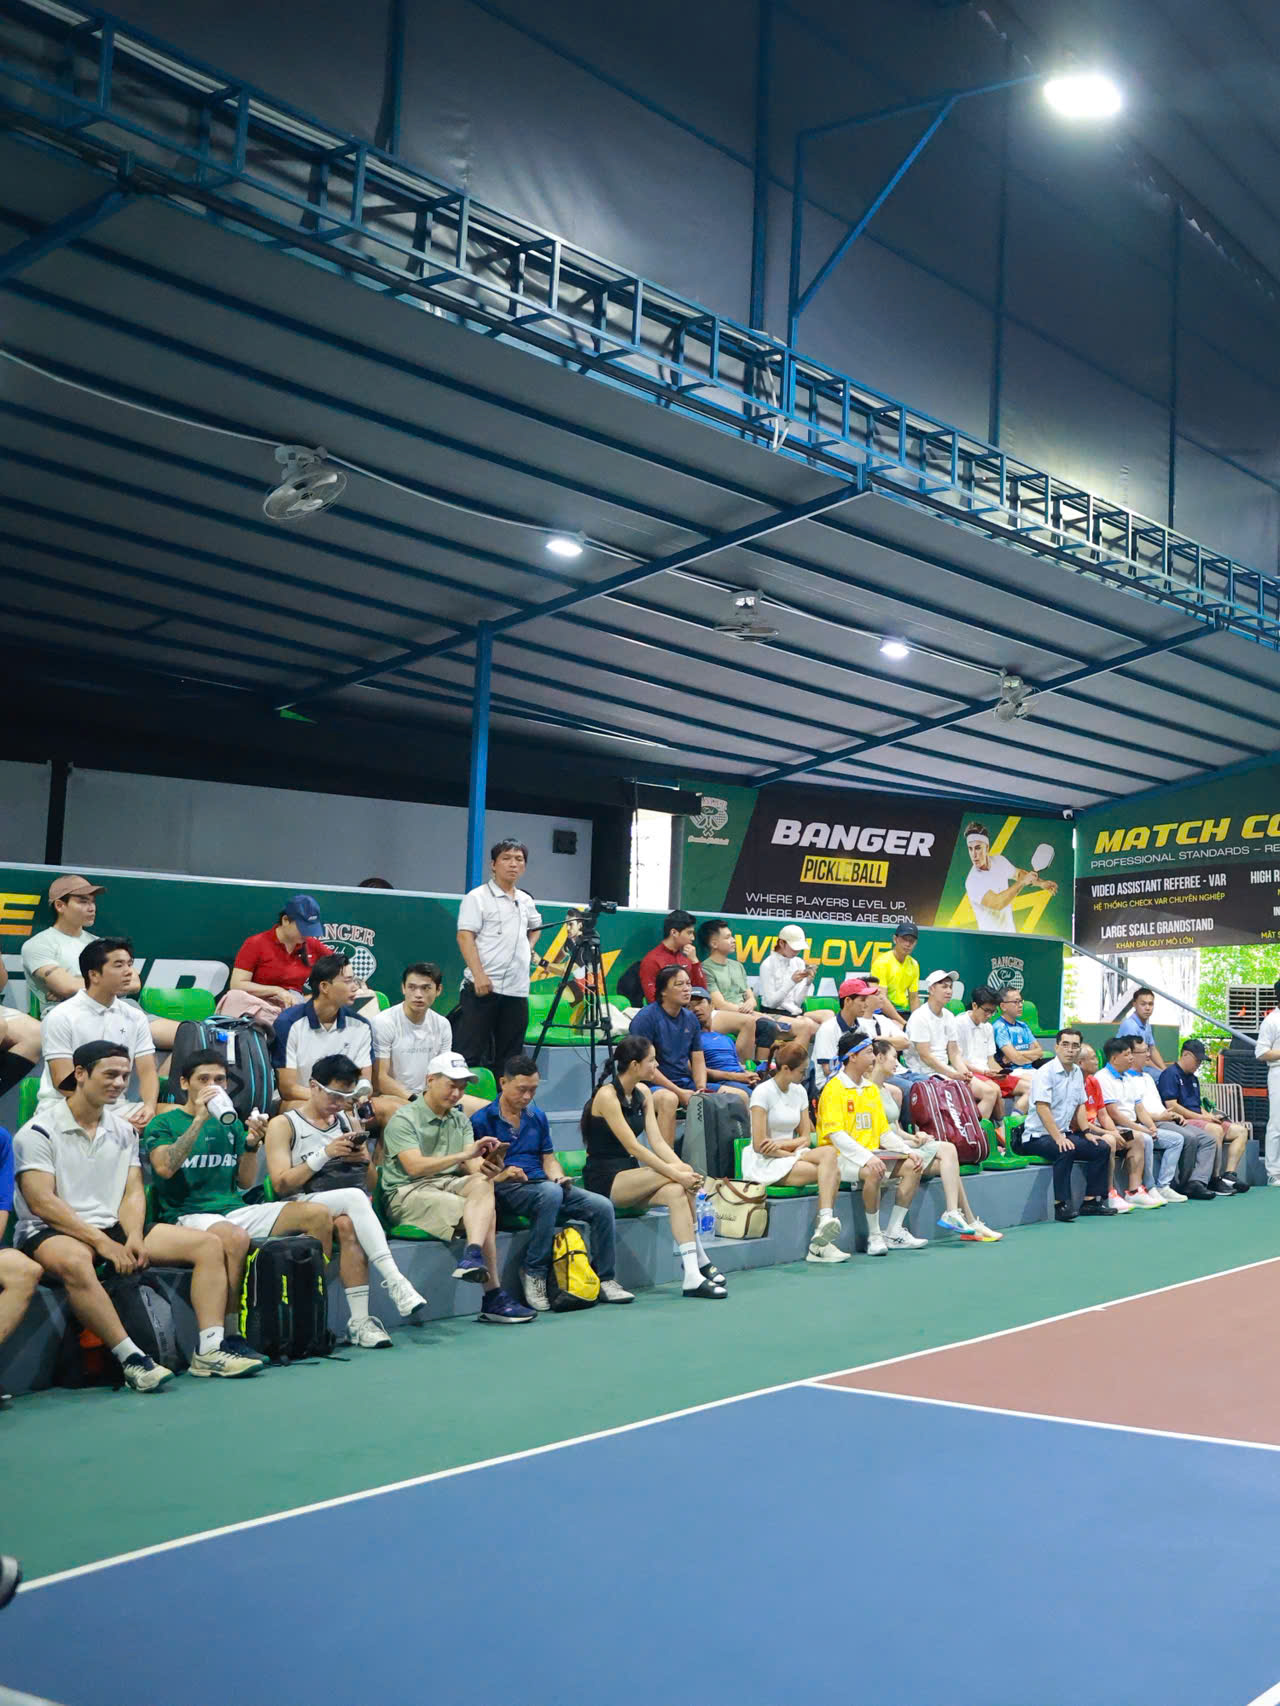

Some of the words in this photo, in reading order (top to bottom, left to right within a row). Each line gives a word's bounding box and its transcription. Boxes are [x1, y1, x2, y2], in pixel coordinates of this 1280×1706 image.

[771, 818, 936, 857] BANGER
[1094, 817, 1232, 854] MATCH
[1090, 853, 1175, 869] PROFESSIONAL
[1178, 846, 1250, 860] STANDARDS
[1091, 883, 1116, 898] VIDEO
[1117, 879, 1162, 895] ASSISTANT
[1163, 875, 1201, 891] REFEREE
[1208, 873, 1227, 887] VAR
[1250, 870, 1272, 884] HIGH
[745, 892, 793, 905] WHERE
[795, 895, 850, 908] PLAYERS
[852, 899, 887, 910] LEVEL
[889, 901, 908, 911] UP.
[1129, 898, 1153, 908] CHECK
[1154, 896, 1168, 905] VAR
[1169, 893, 1198, 904] CHUYÊN
[1199, 891, 1226, 902] NGHIỆP
[745, 907, 793, 917] WHERE
[795, 910, 853, 921] BANGERS
[855, 913, 880, 923] ARE
[881, 914, 916, 924] BORN.
[314, 923, 376, 946] NGER
[1101, 925, 1127, 939] LARGE
[1128, 922, 1156, 937] SCALE
[1156, 918, 1214, 934] GRANDSTAND
[1148, 938, 1165, 947] QUY
[991, 956, 1024, 971] BANGER
